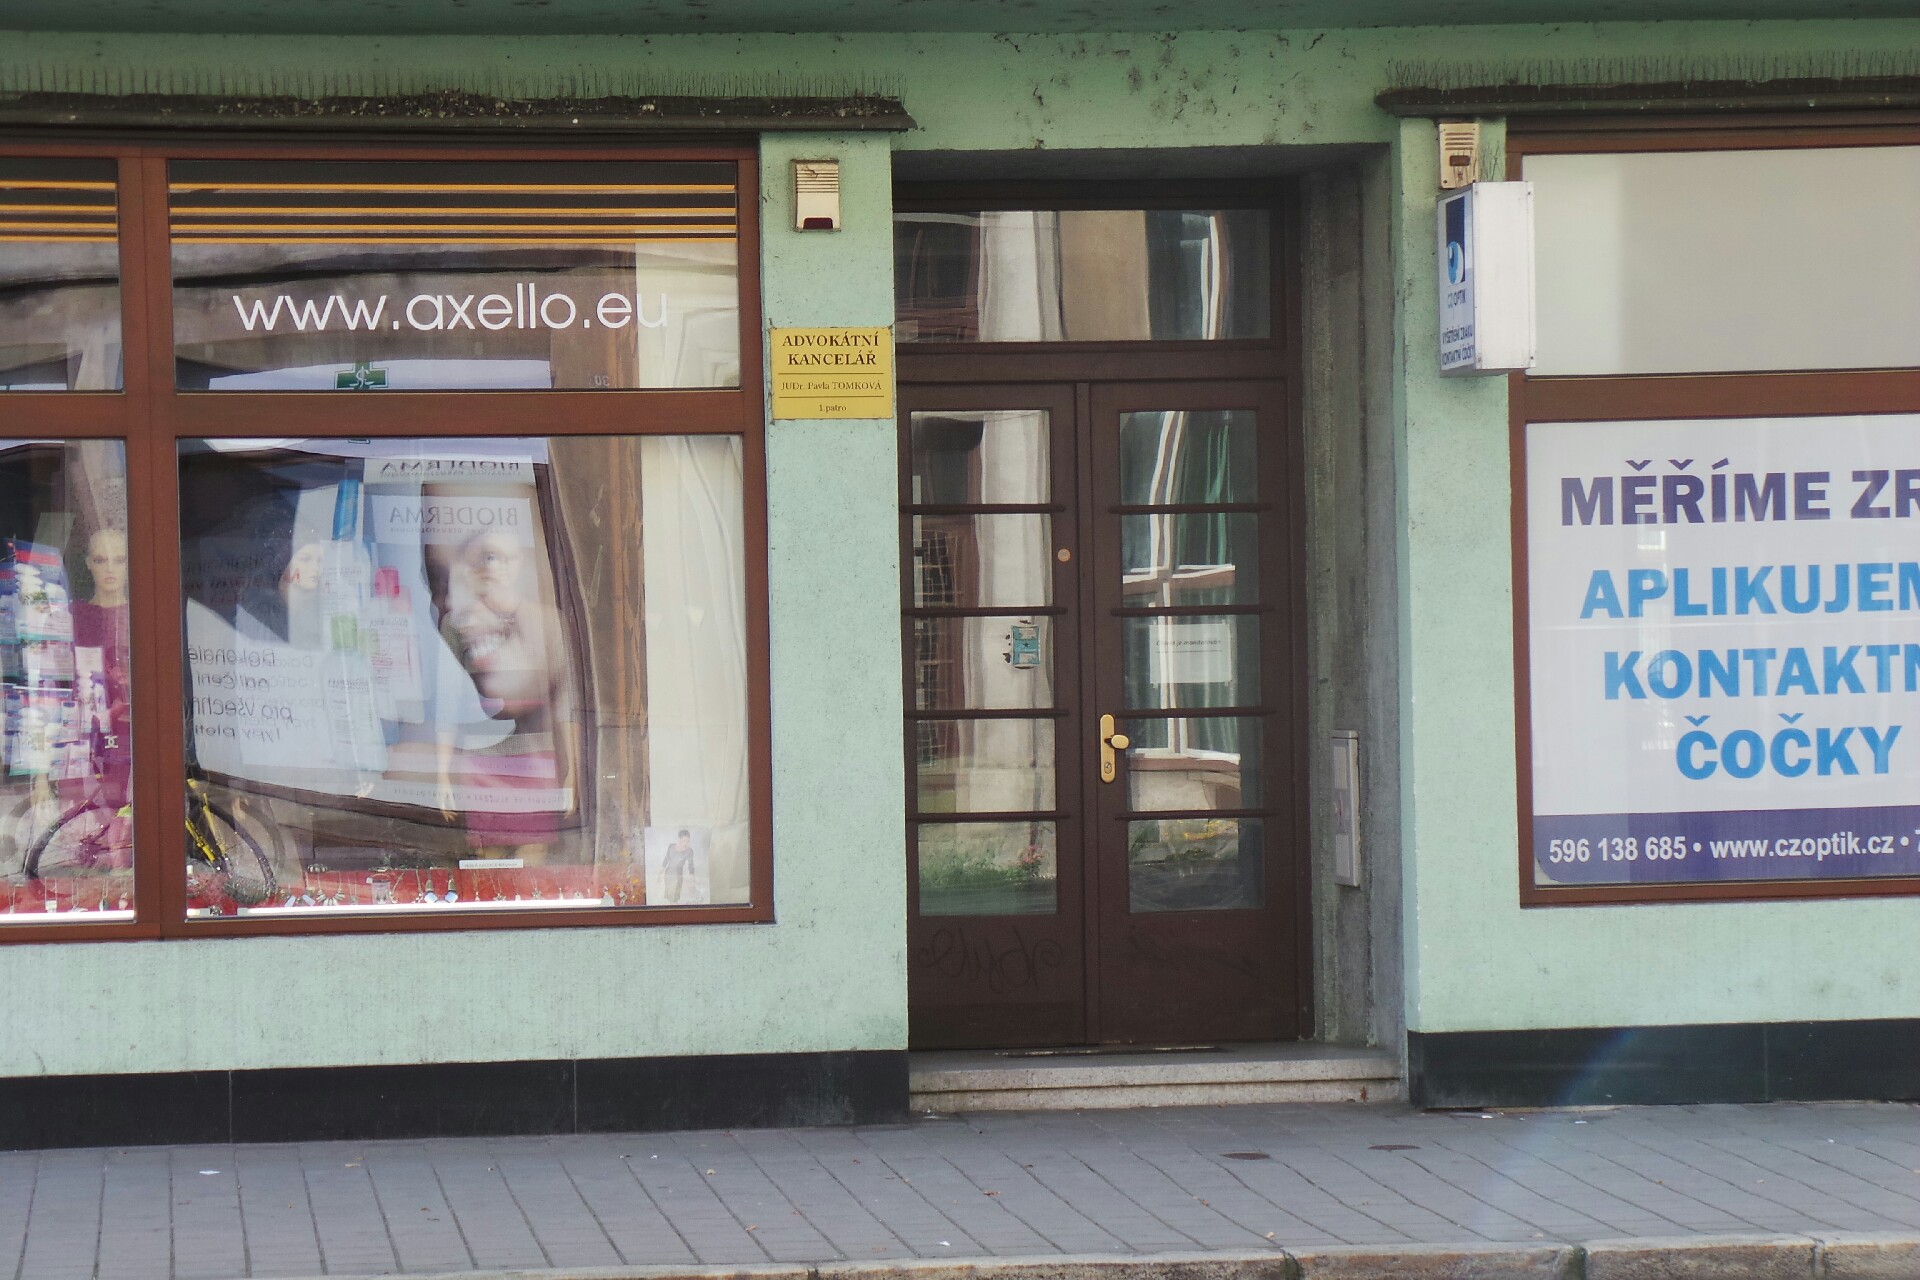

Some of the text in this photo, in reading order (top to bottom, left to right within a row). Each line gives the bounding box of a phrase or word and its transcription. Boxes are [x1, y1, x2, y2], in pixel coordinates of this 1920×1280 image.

[232, 281, 669, 332] www.axello.eu
[782, 331, 879, 347] ADVOKÁTNÍ
[788, 350, 877, 366] KANCELÁŘ
[781, 380, 882, 391] JUDr. Pavla TOMKOVÁ
[1560, 458, 1831, 526] MĚŘÍME
[1675, 713, 1903, 781] ČOČKY
[1549, 837, 1590, 864] 596
[1597, 836, 1638, 862] 138
[1645, 834, 1687, 861] 685
[1709, 831, 1894, 863] www.czoptik.cz
